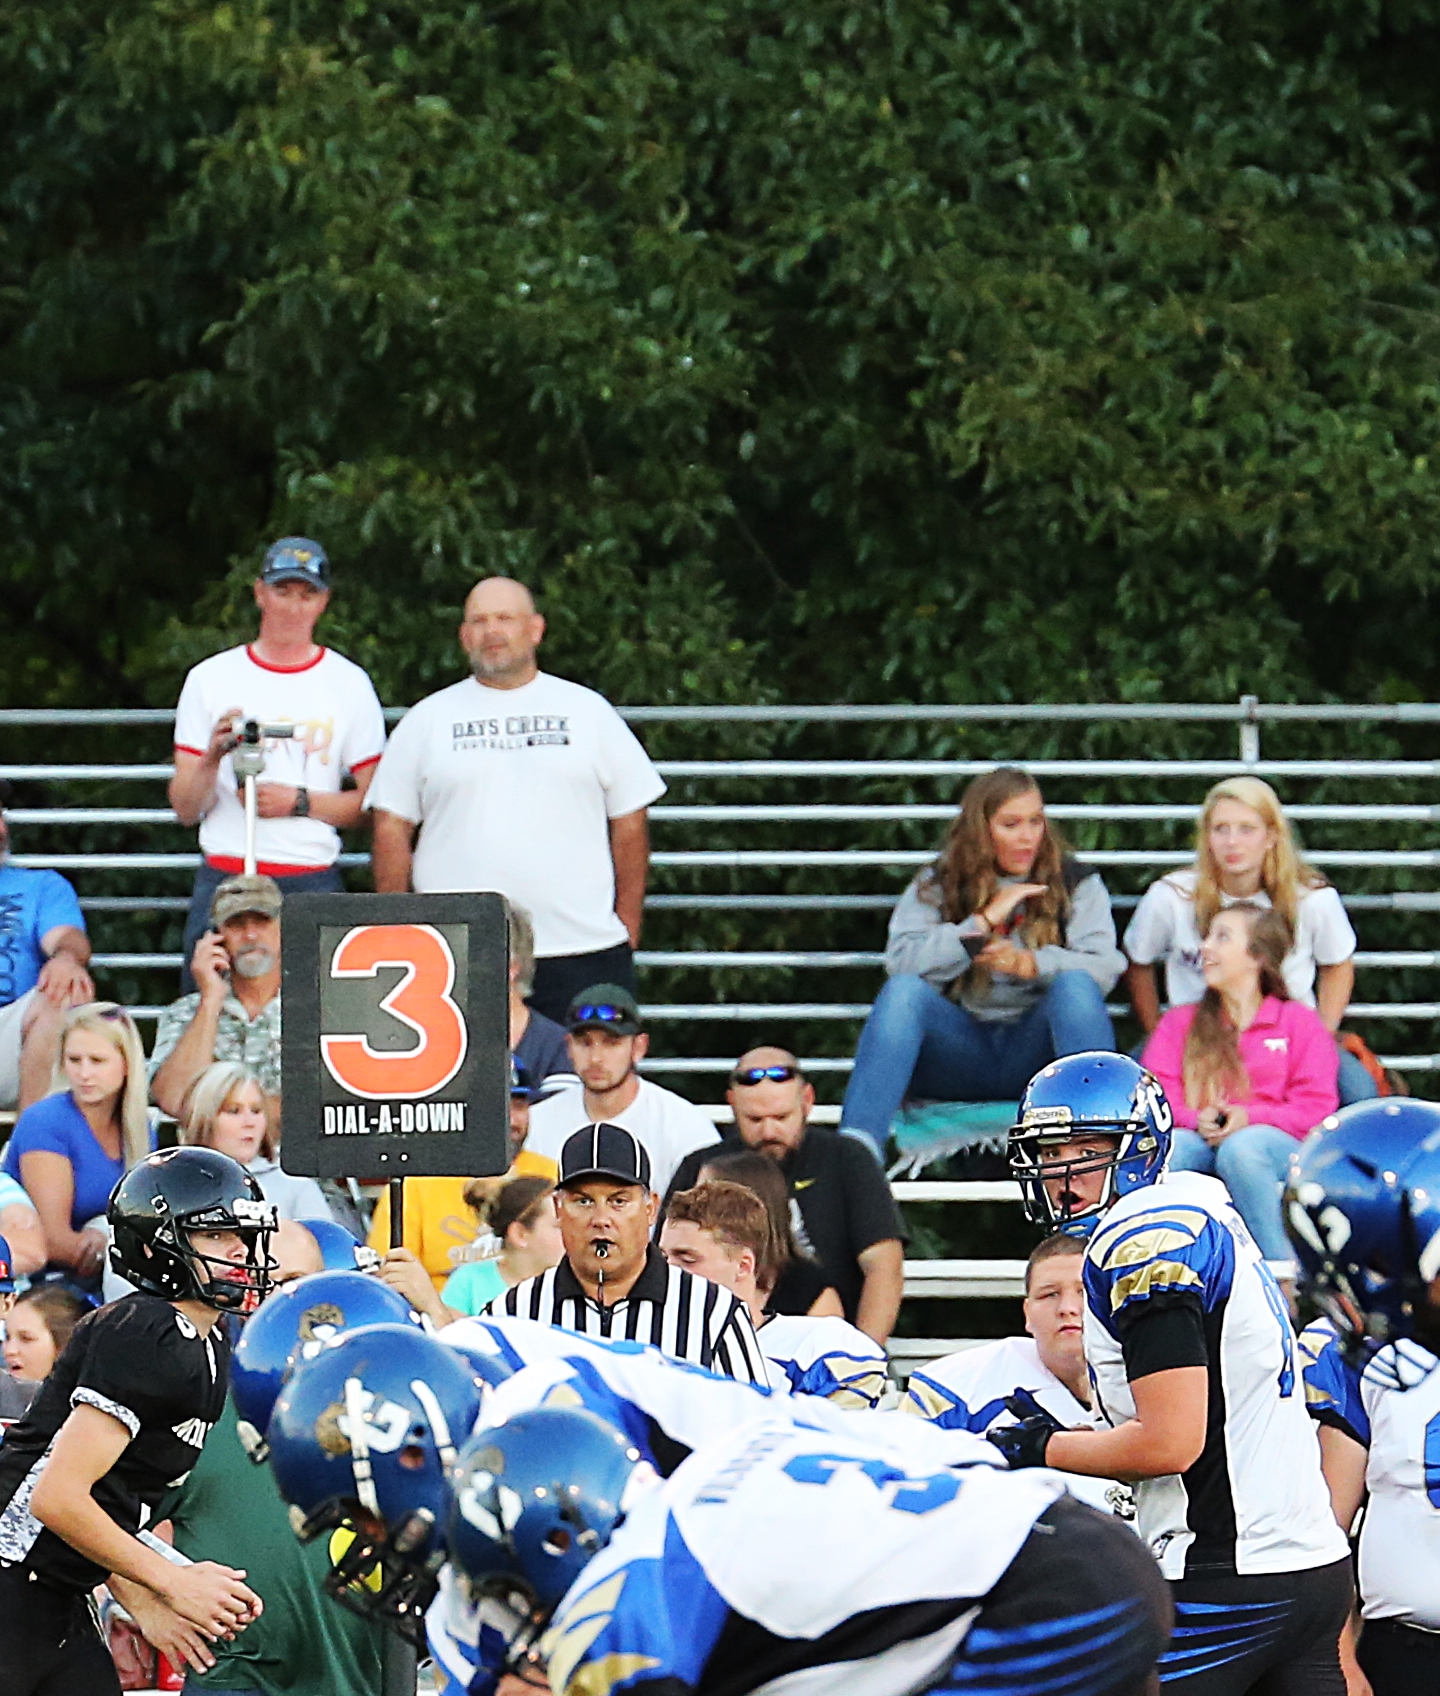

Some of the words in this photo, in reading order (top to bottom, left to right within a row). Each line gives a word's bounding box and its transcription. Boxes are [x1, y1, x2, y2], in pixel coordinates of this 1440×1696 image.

[451, 718, 500, 739] DAYS
[505, 716, 570, 736] CREEK
[320, 924, 469, 1100] 3
[323, 1103, 466, 1134] DIAL-A-DOWN
